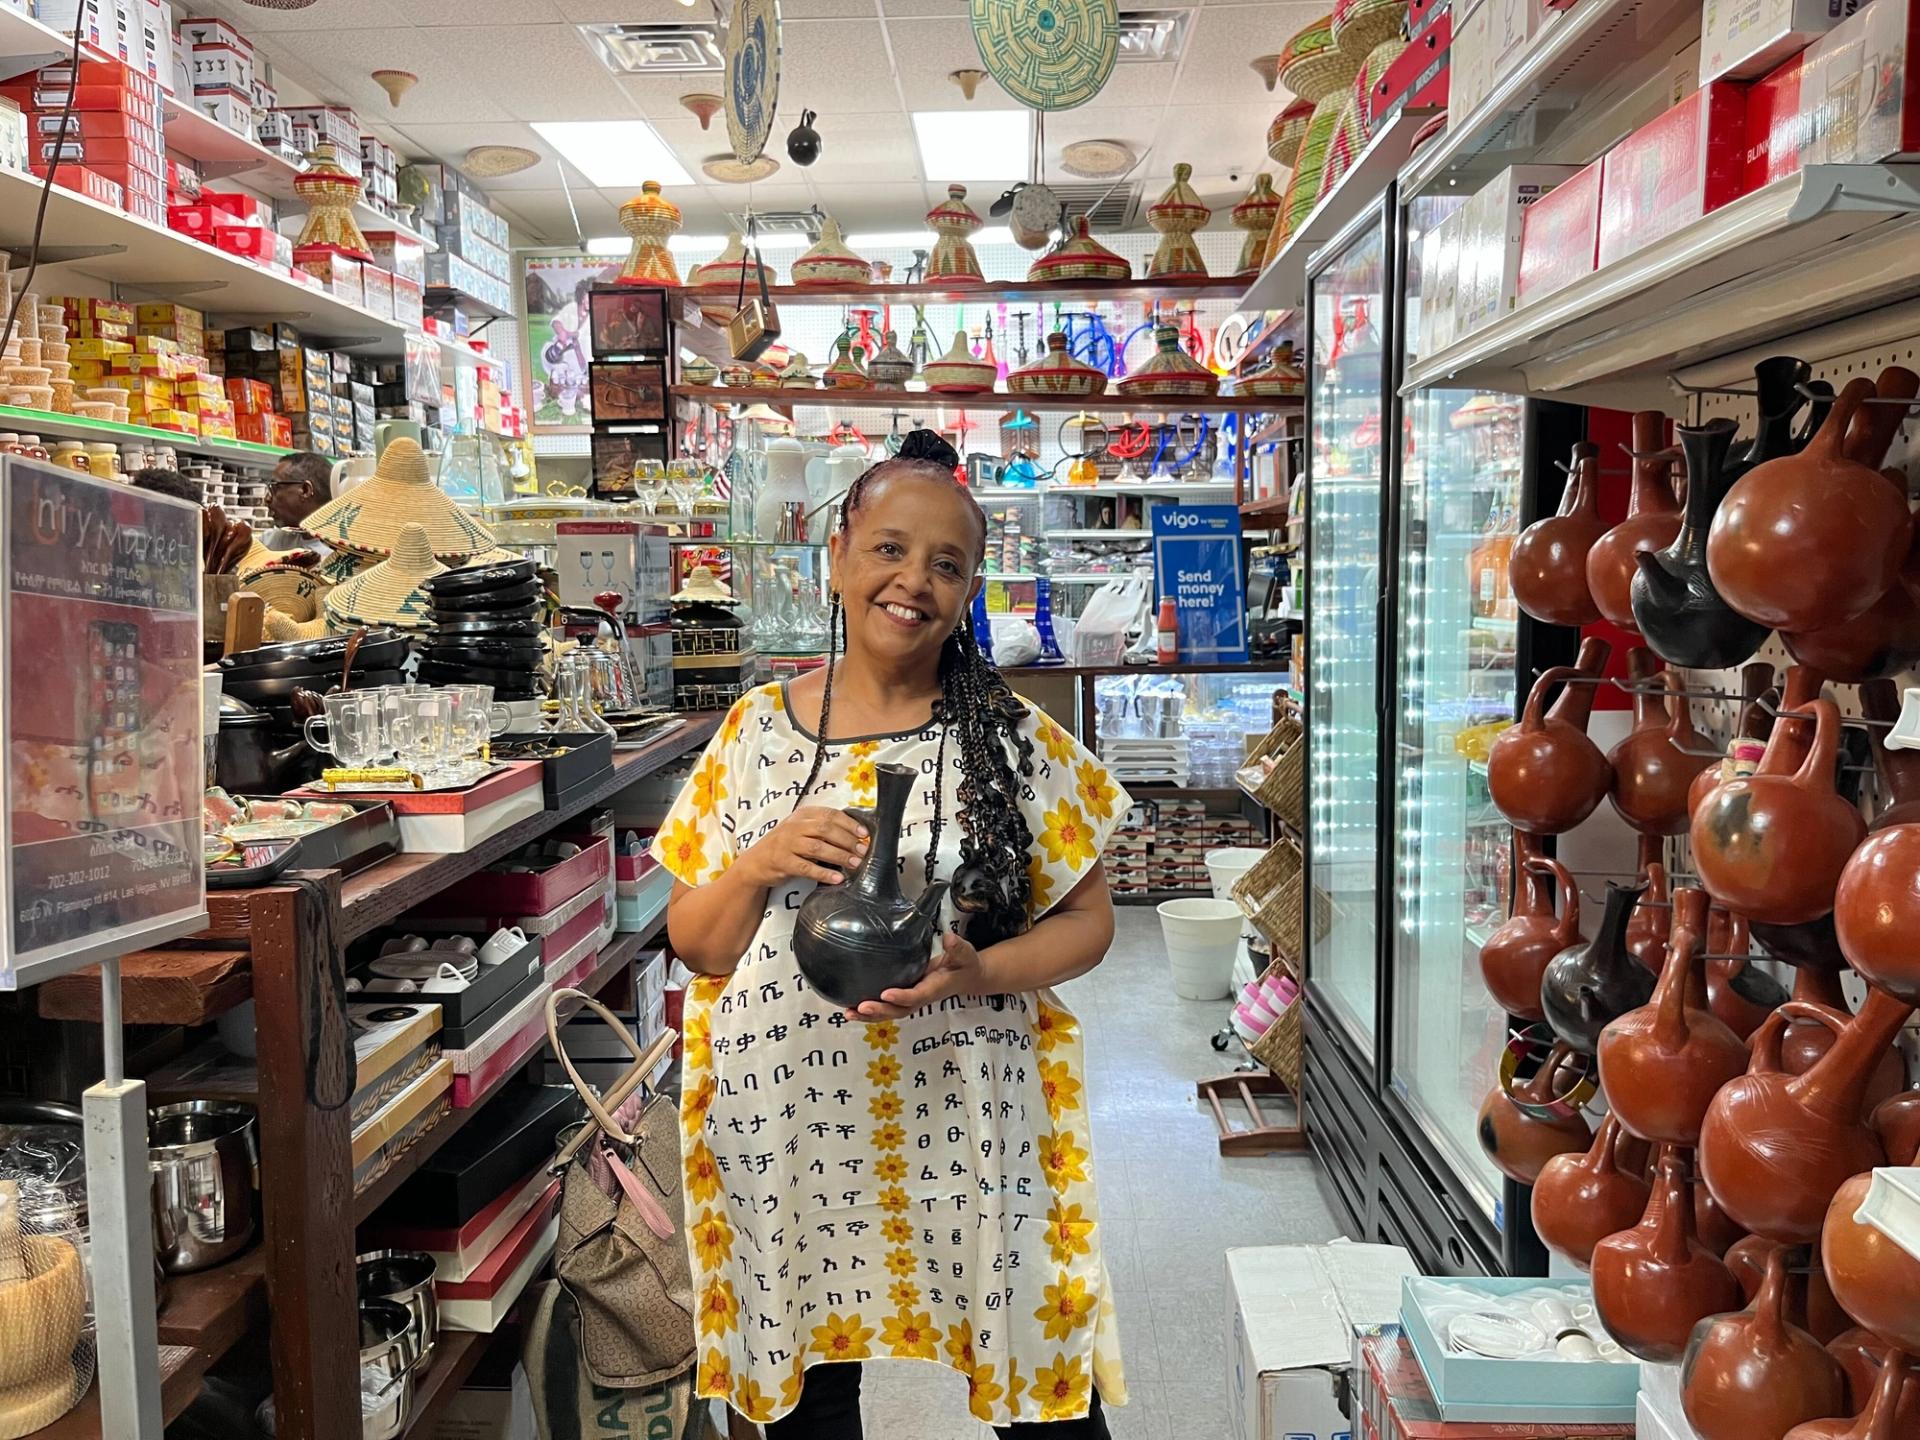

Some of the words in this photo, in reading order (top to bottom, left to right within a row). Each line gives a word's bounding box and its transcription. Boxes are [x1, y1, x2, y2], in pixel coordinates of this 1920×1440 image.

[1162, 511, 1199, 529] vigo
[1178, 570, 1212, 582] Send
[1178, 584, 1225, 597] money
[1179, 596, 1214, 608] here!
